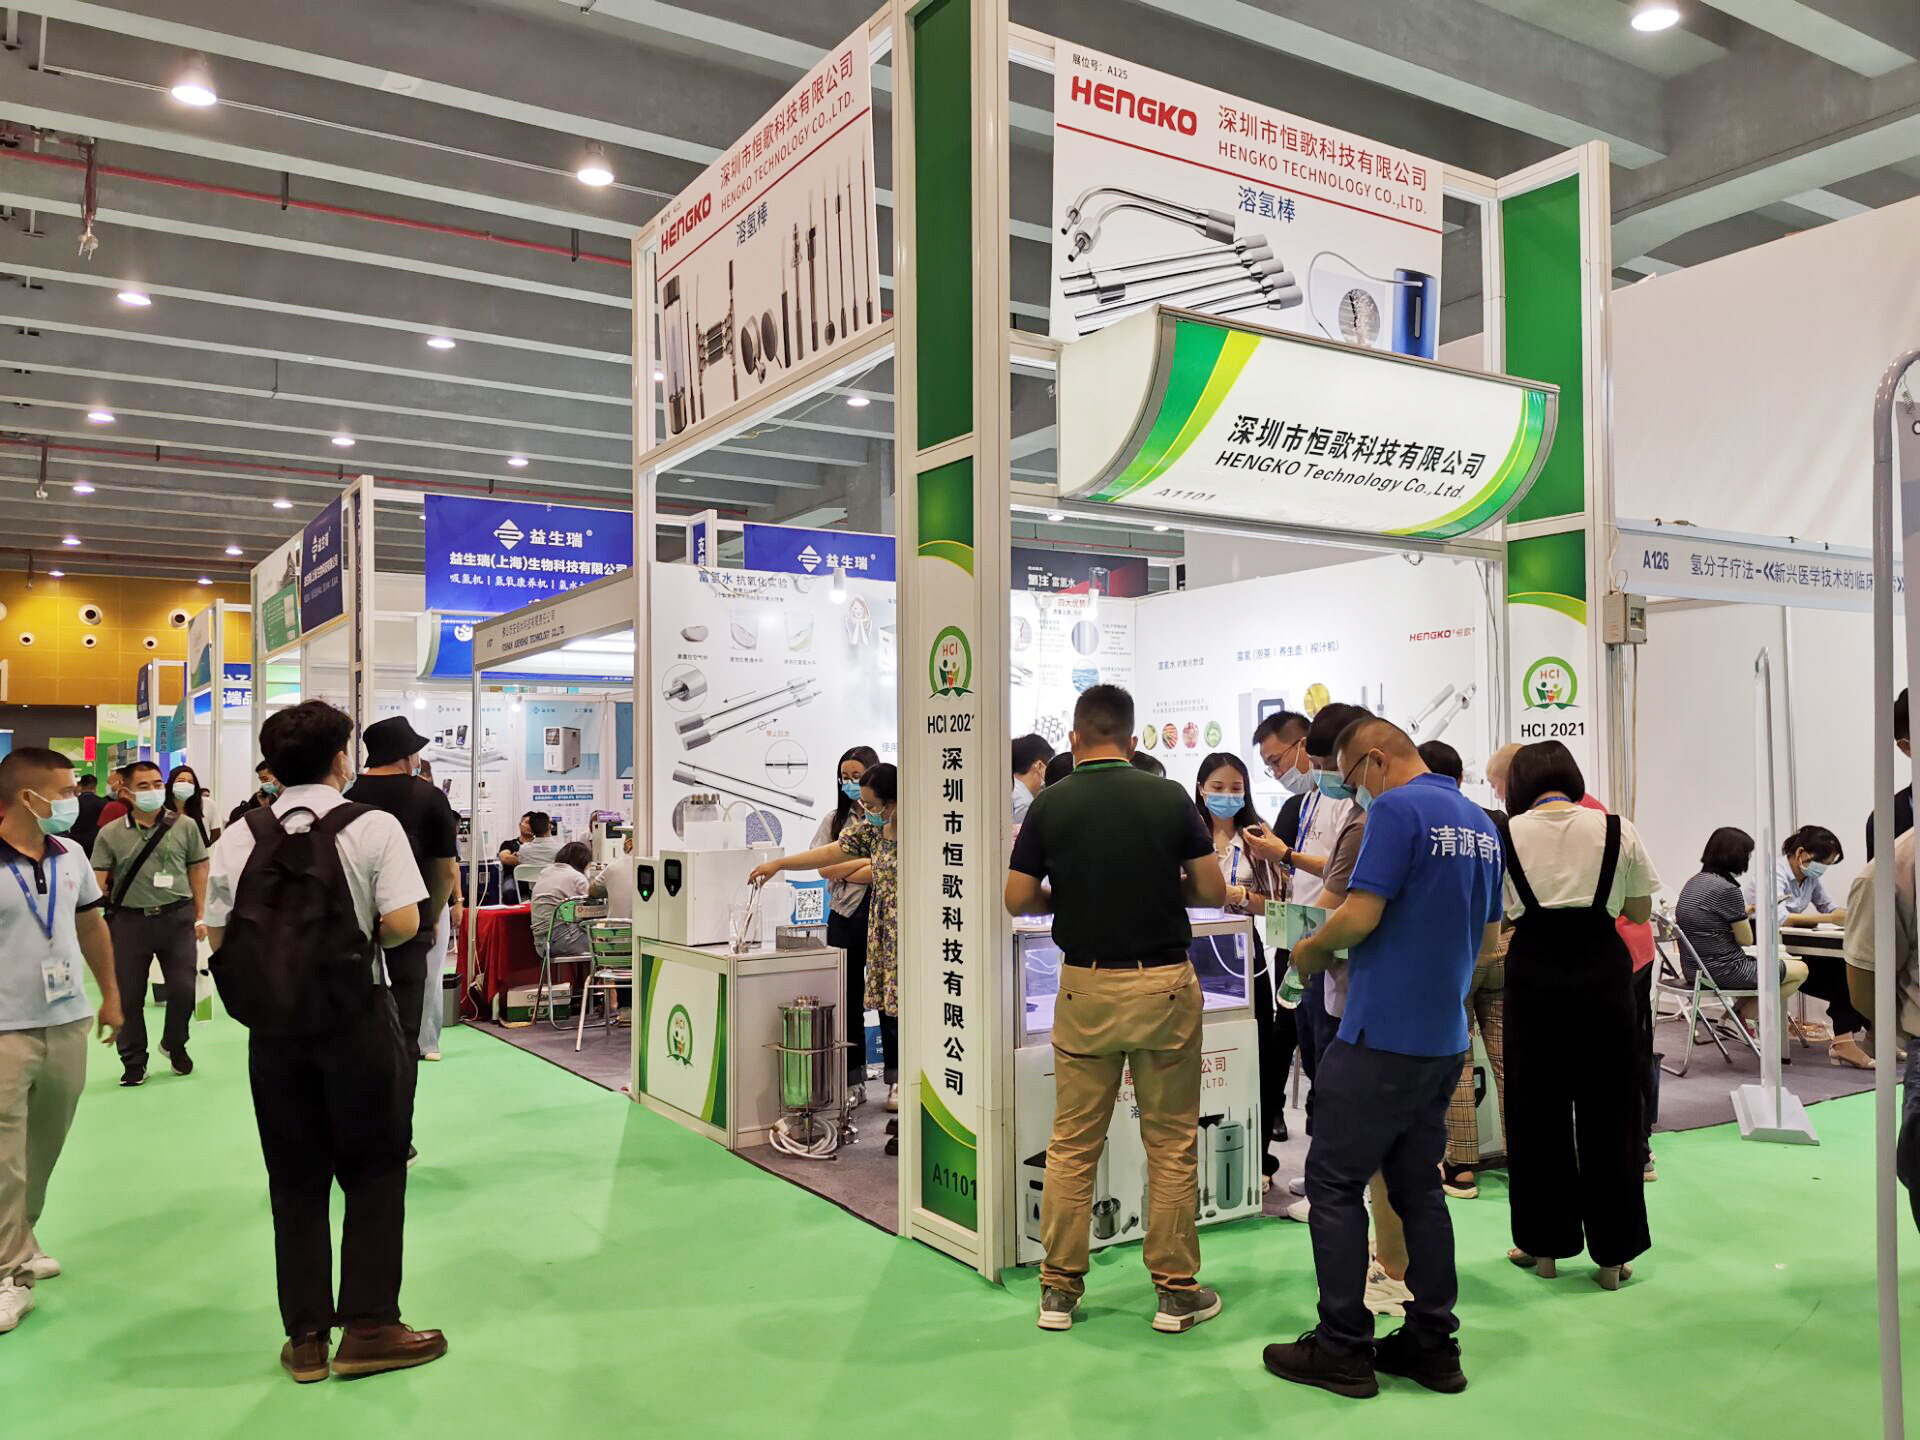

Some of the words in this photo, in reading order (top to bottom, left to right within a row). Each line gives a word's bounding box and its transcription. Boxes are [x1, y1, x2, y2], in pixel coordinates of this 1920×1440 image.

[1107, 65, 1128, 80] A125
[720, 50, 854, 190] 深圳市恒歌科技有限公司
[1071, 75, 1197, 136] HENGKO
[721, 174, 752, 212] HENGKO
[753, 129, 809, 184] TECHNOLOGY
[811, 91, 855, 136] CO.,LTD.
[1218, 104, 1428, 191] 深圳市恒歌科技有限公司
[1218, 140, 1278, 171] HENGKO
[1283, 160, 1371, 197] TECHNOLOGY
[1374, 186, 1428, 215] CO.,LTD.
[1237, 184, 1296, 224] 溶氢棒
[661, 192, 712, 255] HENGKO
[736, 201, 768, 247] 溶氢棒
[1228, 414, 1487, 480] 深圳市恒歌科技有限公司
[1215, 450, 1300, 476] HENGKO
[1303, 463, 1404, 492] Technology
[1403, 477, 1464, 500] Co.,Ltd.
[1154, 488, 1216, 502] A1101
[529, 528, 583, 548] 益生瑞
[826, 554, 868, 570] 益生瑞
[1643, 550, 1669, 570] A126
[558, 579, 586, 591] 氢水
[940, 642, 958, 657] HCI
[1409, 630, 1451, 642] HENGKO
[1540, 669, 1560, 680] HCI
[223, 690, 252, 706] 端品
[928, 714, 948, 735] HCI
[950, 713, 975, 733] 202
[1521, 723, 1546, 739] HCI
[1550, 722, 1585, 738] 2021
[942, 747, 964, 1096] 深圳市恒歌科技有限公司
[932, 1163, 977, 1201] A1101
